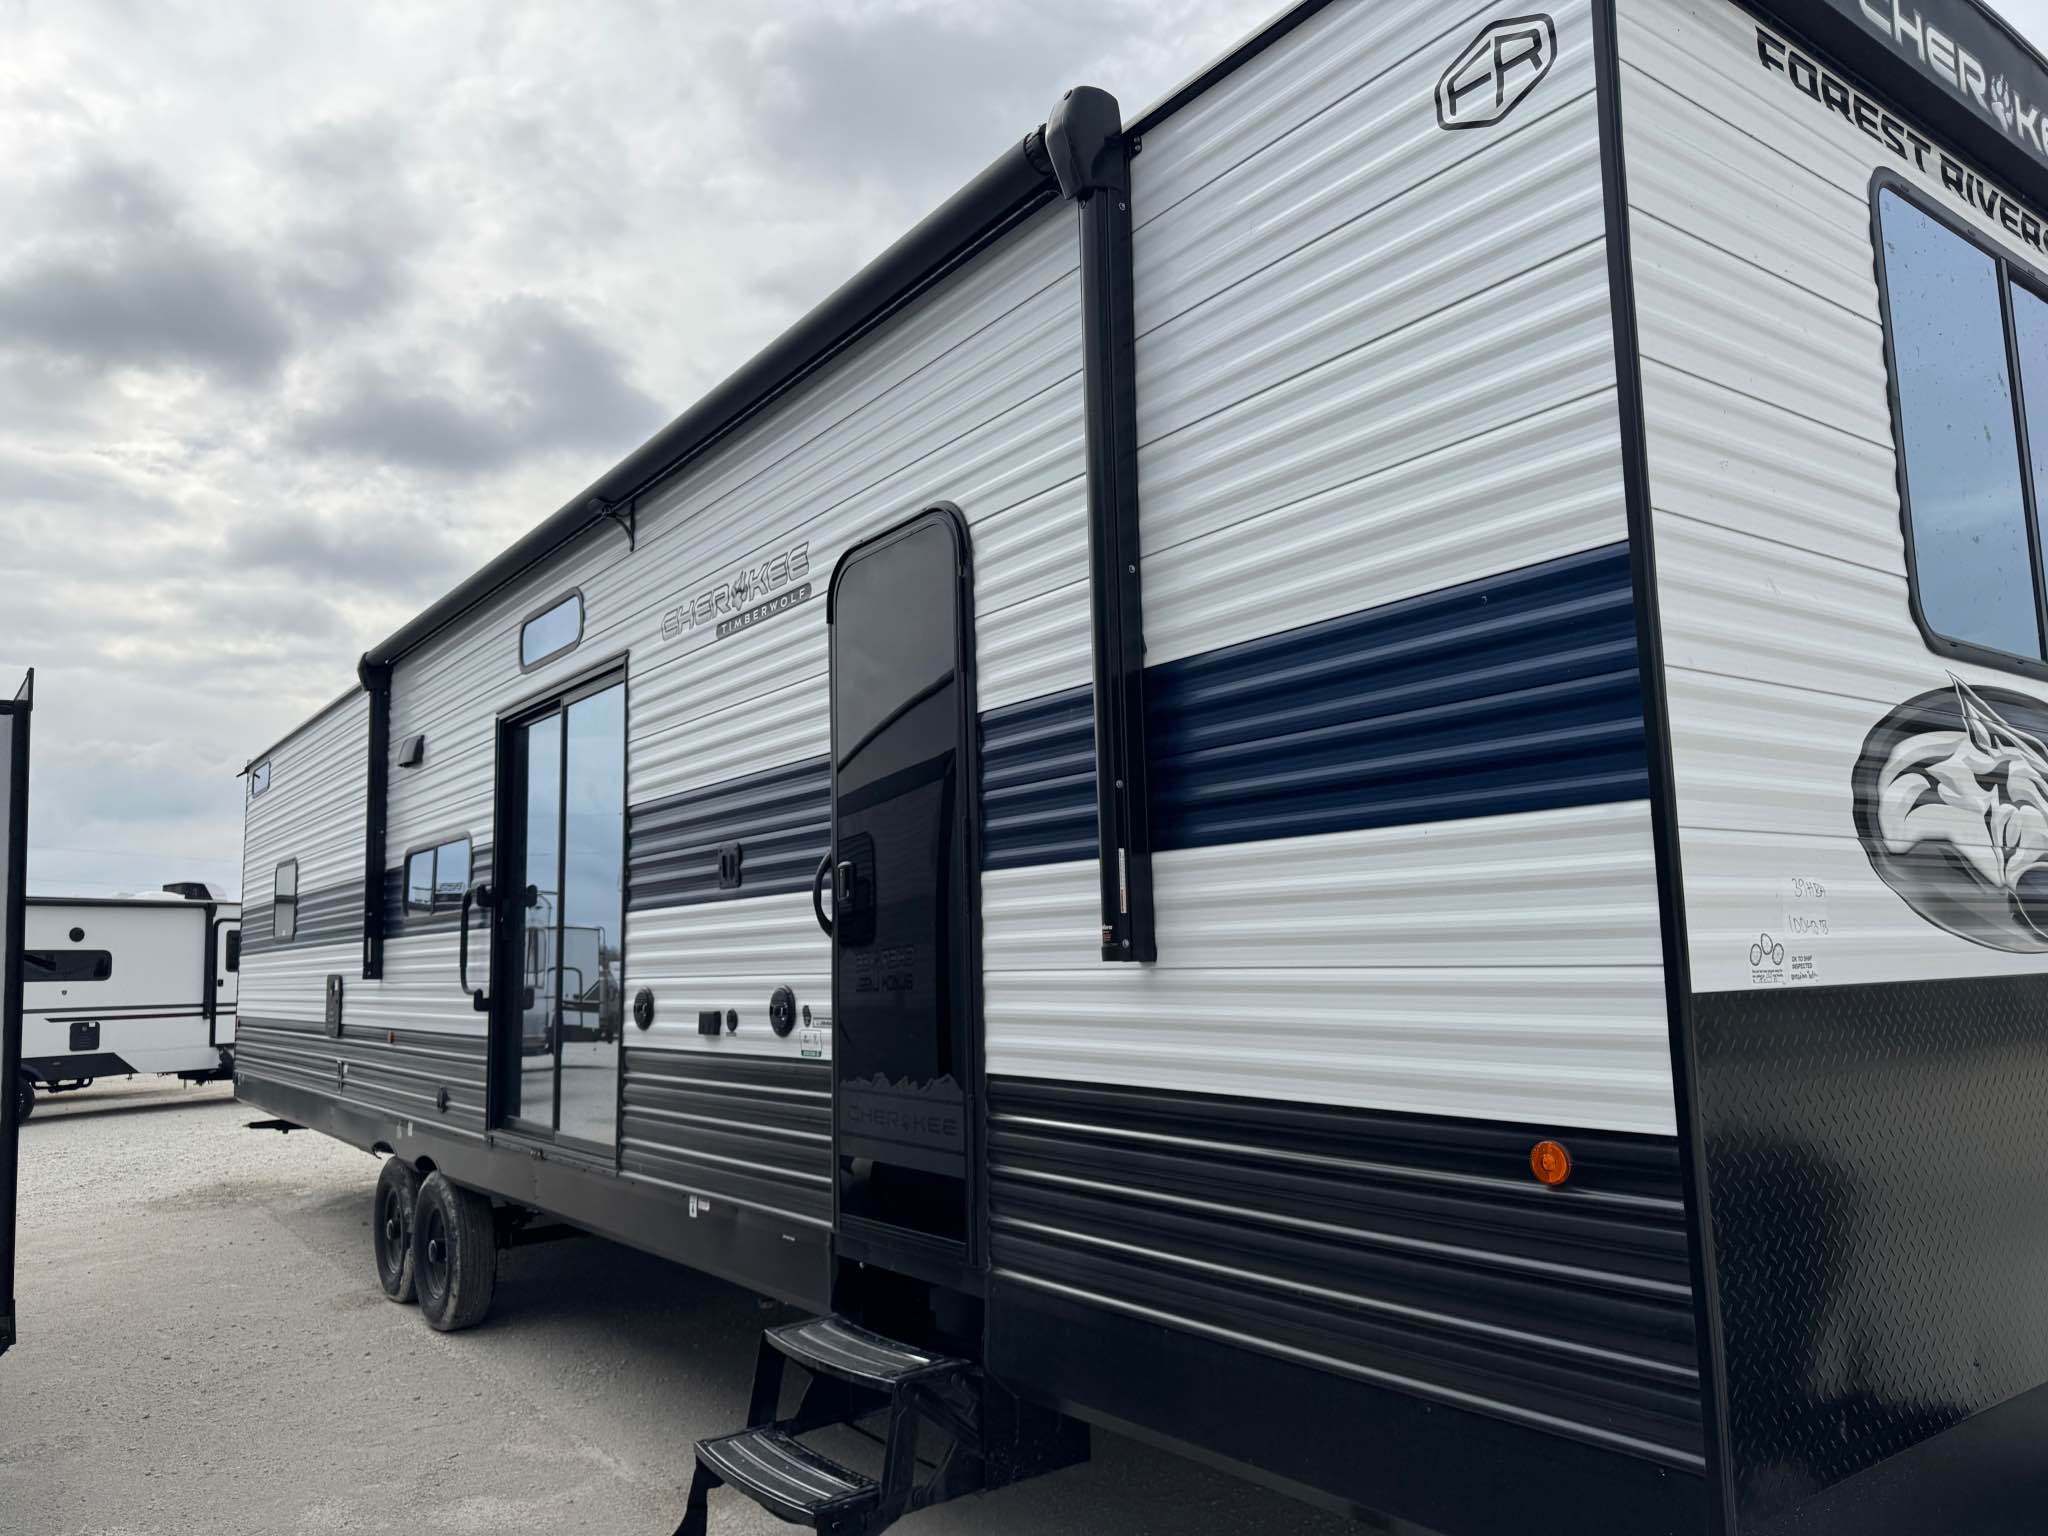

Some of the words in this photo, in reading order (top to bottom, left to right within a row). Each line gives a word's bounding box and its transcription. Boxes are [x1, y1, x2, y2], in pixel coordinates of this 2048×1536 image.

[1755, 24, 1931, 174] FOREST
[1940, 153, 2044, 255] RIVER
[720, 587, 807, 635] TIMBERWOLF
